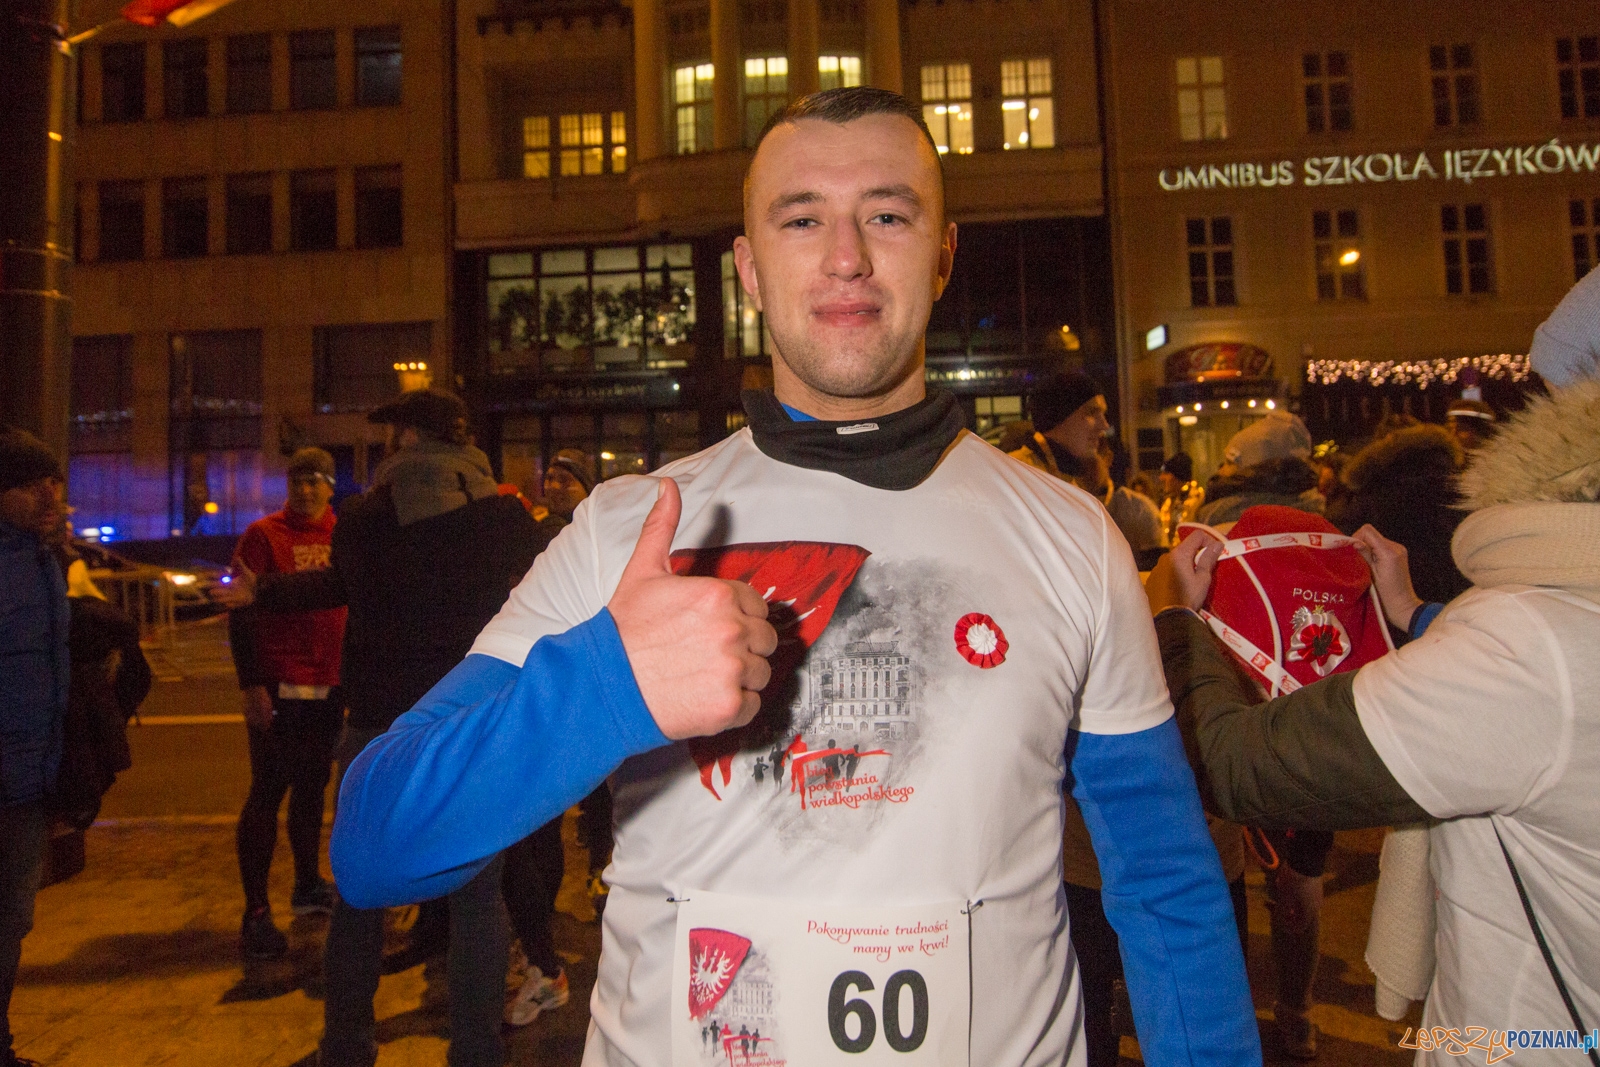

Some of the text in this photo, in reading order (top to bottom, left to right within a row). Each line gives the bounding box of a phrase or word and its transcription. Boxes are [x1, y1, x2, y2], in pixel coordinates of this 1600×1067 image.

[1158, 160, 1295, 191] OMNIBUS
[1303, 152, 1439, 187] SZKOŁA
[1292, 587, 1345, 604] POLSKA
[805, 764, 834, 781] bieg
[808, 773, 878, 799] powstania
[809, 784, 915, 809] wielkopolskiego
[807, 919, 949, 944] Pokonywanie trudności
[853, 934, 949, 963] mamy we krwi!
[827, 969, 929, 1054] 60
